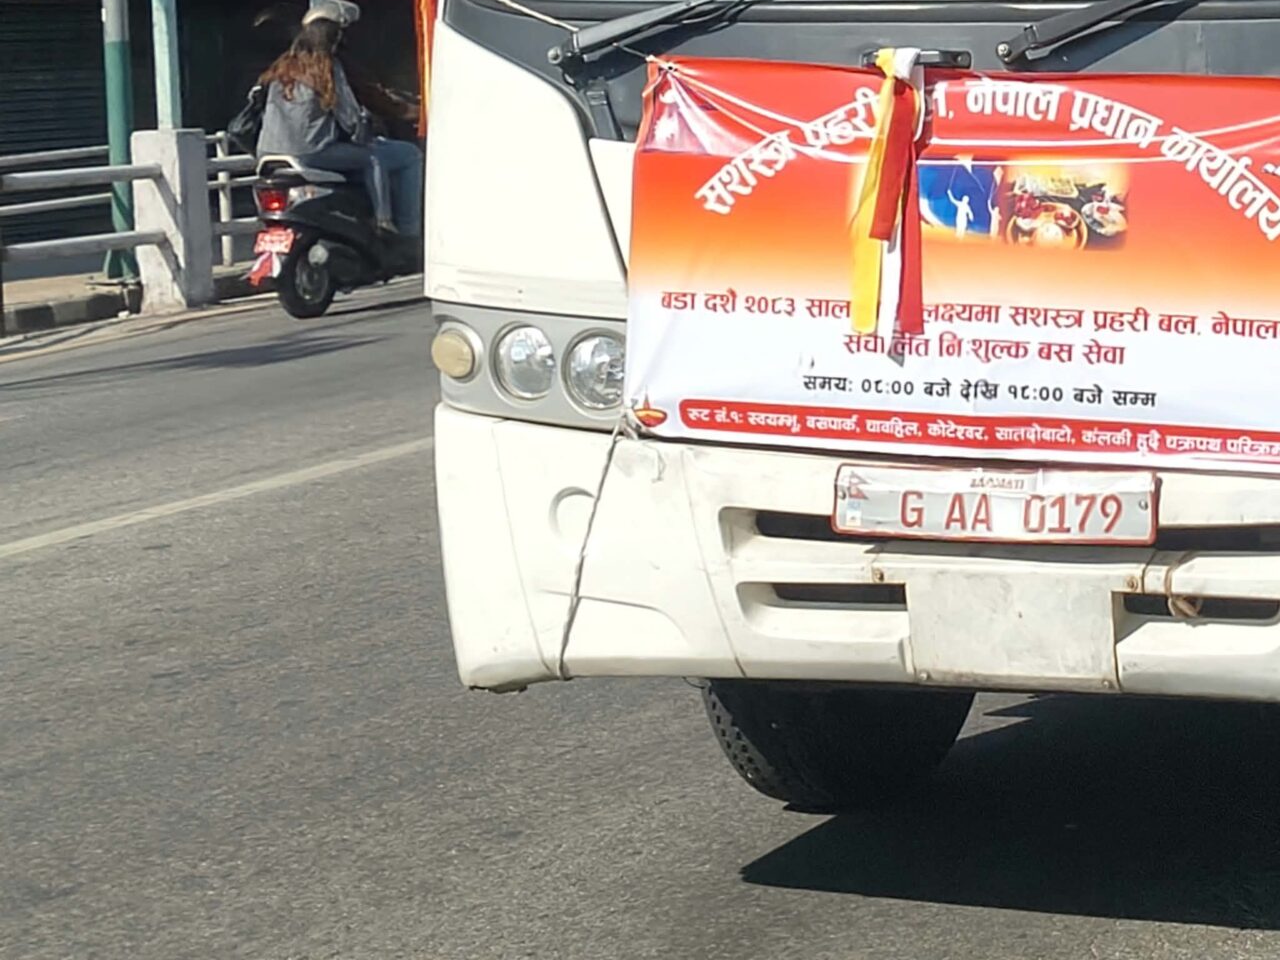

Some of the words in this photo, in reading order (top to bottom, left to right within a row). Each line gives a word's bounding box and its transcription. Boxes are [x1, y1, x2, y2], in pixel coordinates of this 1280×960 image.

[694, 129, 798, 215] सशस्त्र
[966, 78, 1061, 122] नेपाल
[1068, 90, 1162, 150] प्रधान
[660, 291, 697, 311] बडा
[744, 295, 797, 317] २०८३
[1008, 305, 1085, 330] सशस्त्र
[1092, 306, 1150, 333] प्रहरी
[1037, 341, 1075, 364] बस
[1081, 338, 1126, 366] सेवा
[923, 377, 952, 398] बजे
[960, 378, 1000, 403] देखि
[1073, 384, 1103, 406] बजे
[1112, 390, 1157, 408] सम्म
[900, 490, 924, 528] G
[944, 493, 993, 532] AA
[1022, 493, 1123, 534] 0179
